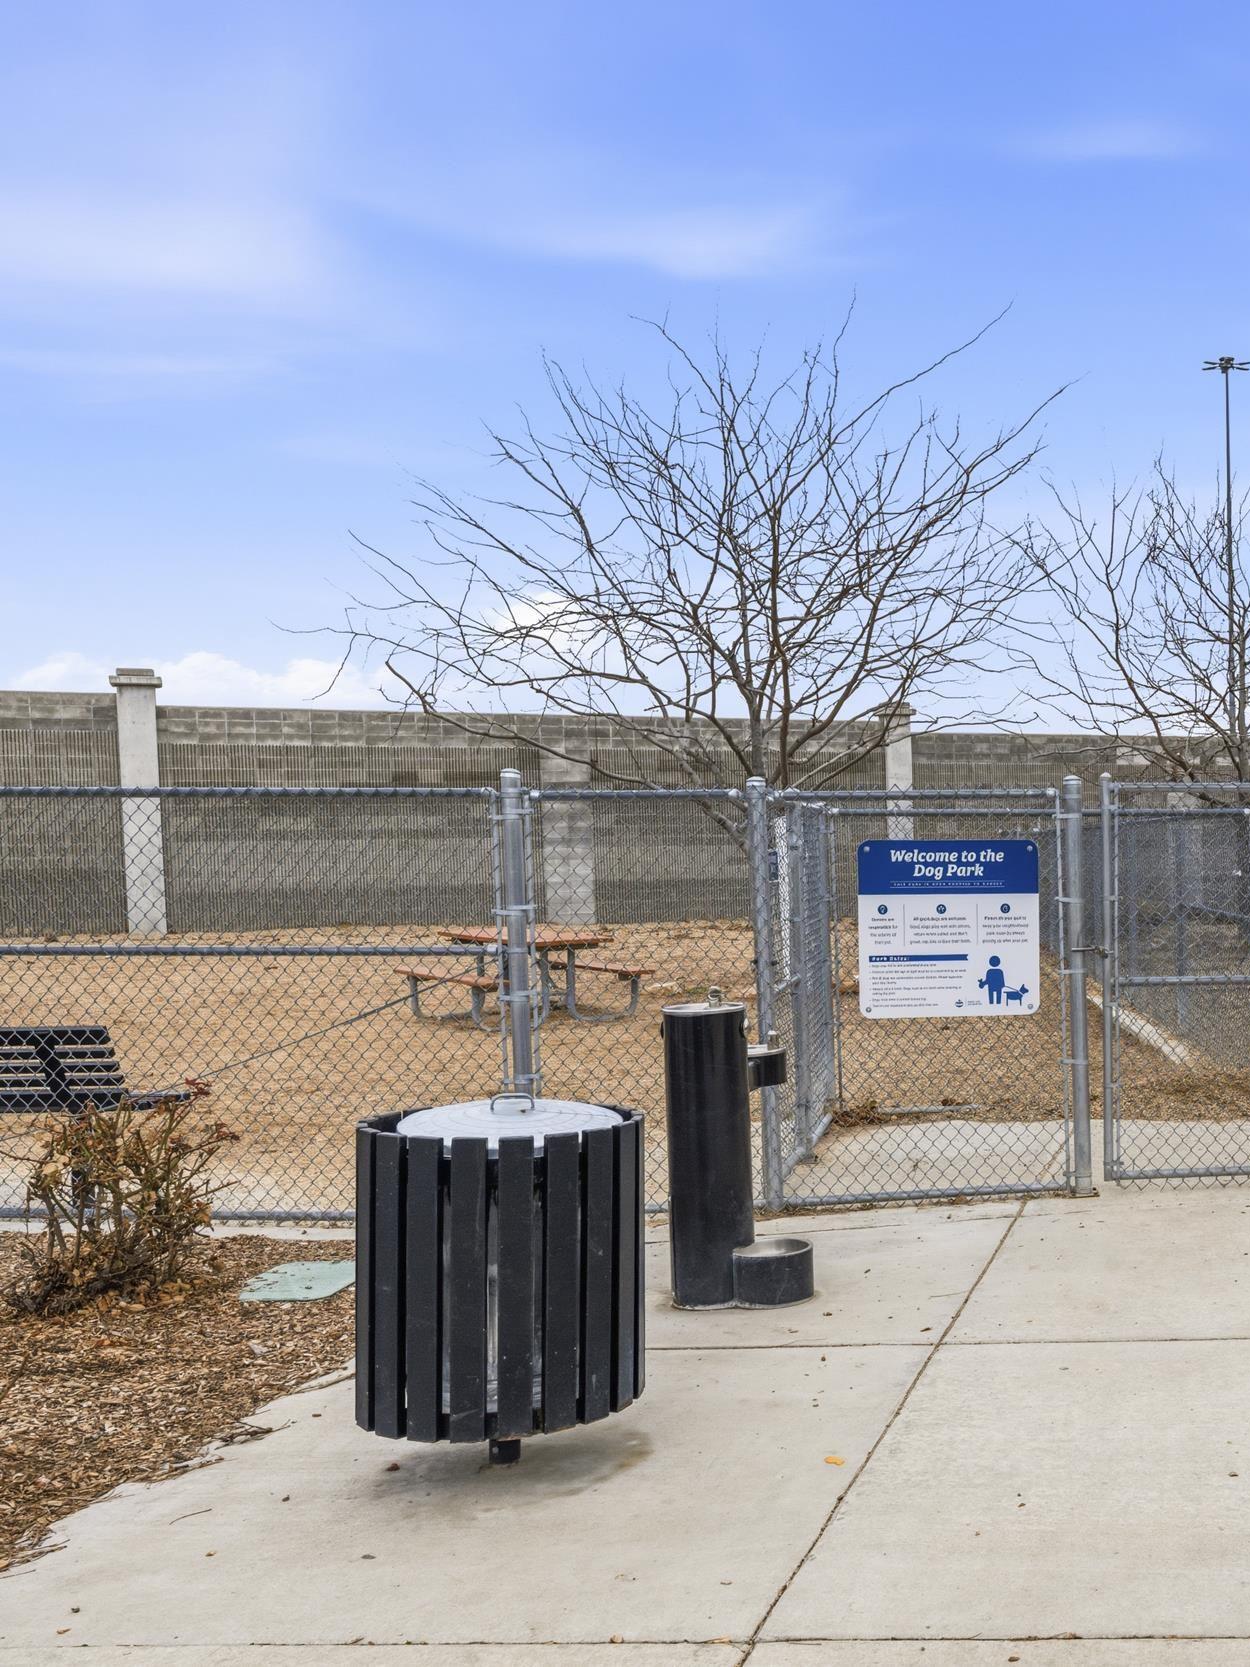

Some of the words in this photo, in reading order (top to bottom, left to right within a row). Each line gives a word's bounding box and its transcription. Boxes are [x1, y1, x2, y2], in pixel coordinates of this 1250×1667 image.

[890, 849, 958, 862] Welcome
[961, 850, 976, 862] to
[980, 849, 1004, 862] the
[913, 864, 943, 880] Dog
[946, 864, 984, 877] Park
